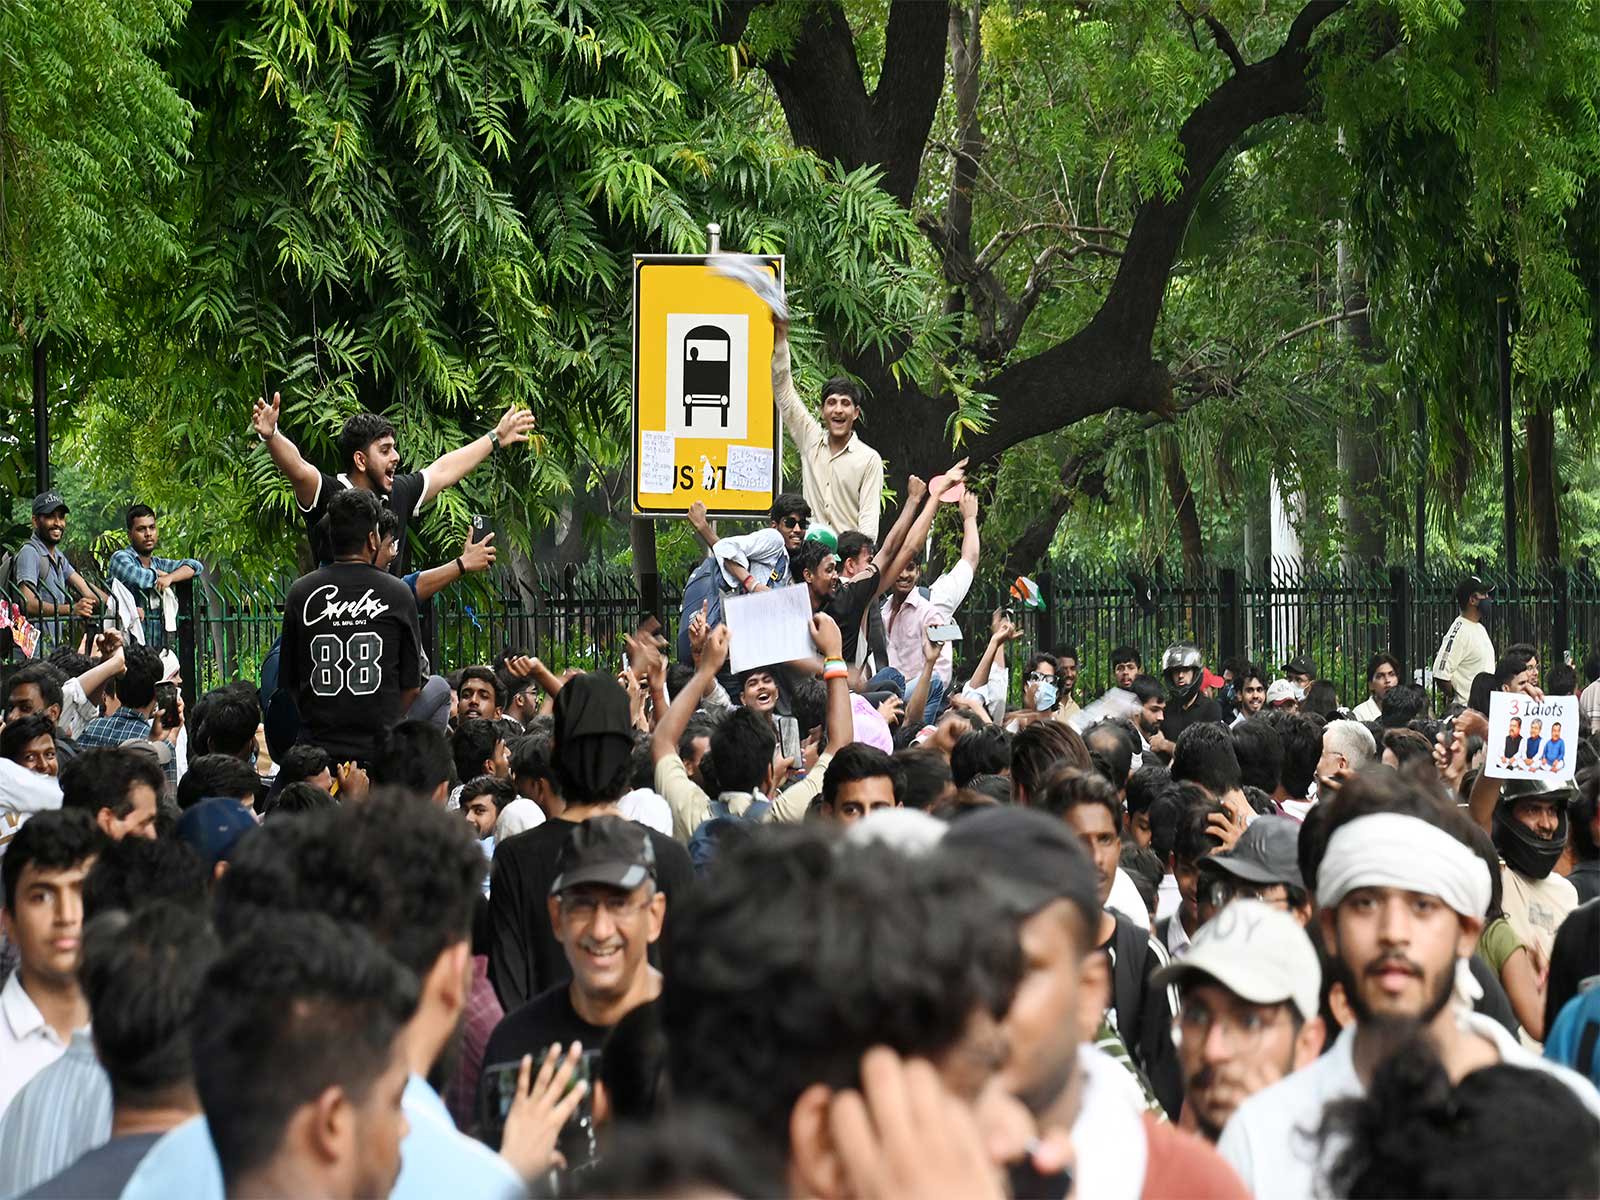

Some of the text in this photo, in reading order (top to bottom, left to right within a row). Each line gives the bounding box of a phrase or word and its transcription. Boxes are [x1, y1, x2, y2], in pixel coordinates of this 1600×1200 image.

[310, 631, 383, 696] 88
[1509, 699, 1563, 717] 3 Idiots
